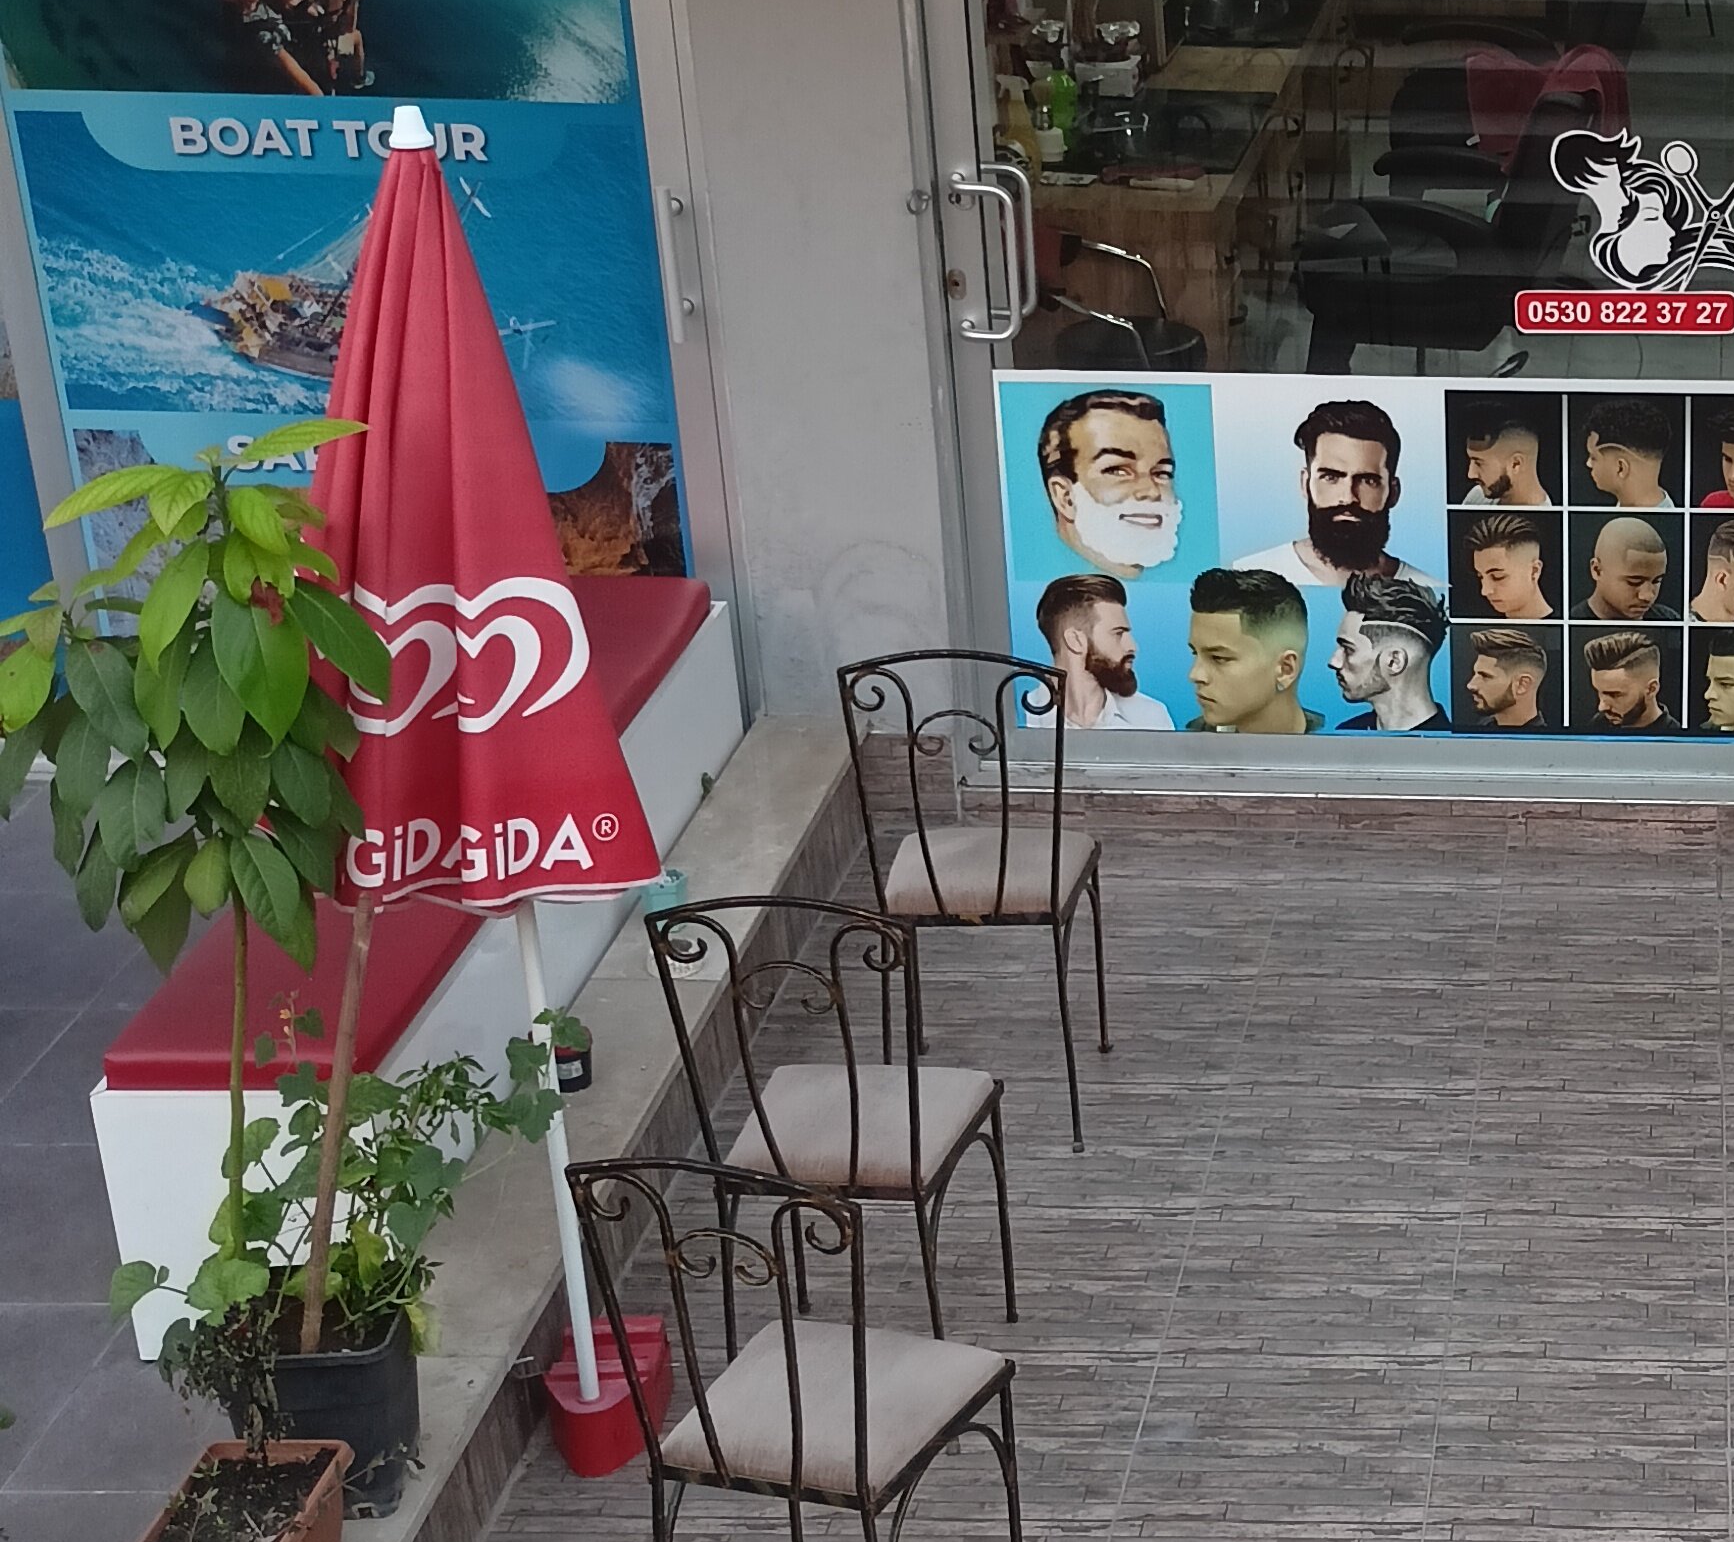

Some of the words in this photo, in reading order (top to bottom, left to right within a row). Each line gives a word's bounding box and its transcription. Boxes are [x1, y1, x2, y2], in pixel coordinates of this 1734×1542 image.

[169, 116, 319, 157] BOAT
[1527, 300, 1592, 323] 0530
[1599, 301, 1648, 323] 822
[1656, 301, 1688, 324] 37
[1695, 302, 1728, 324] 27
